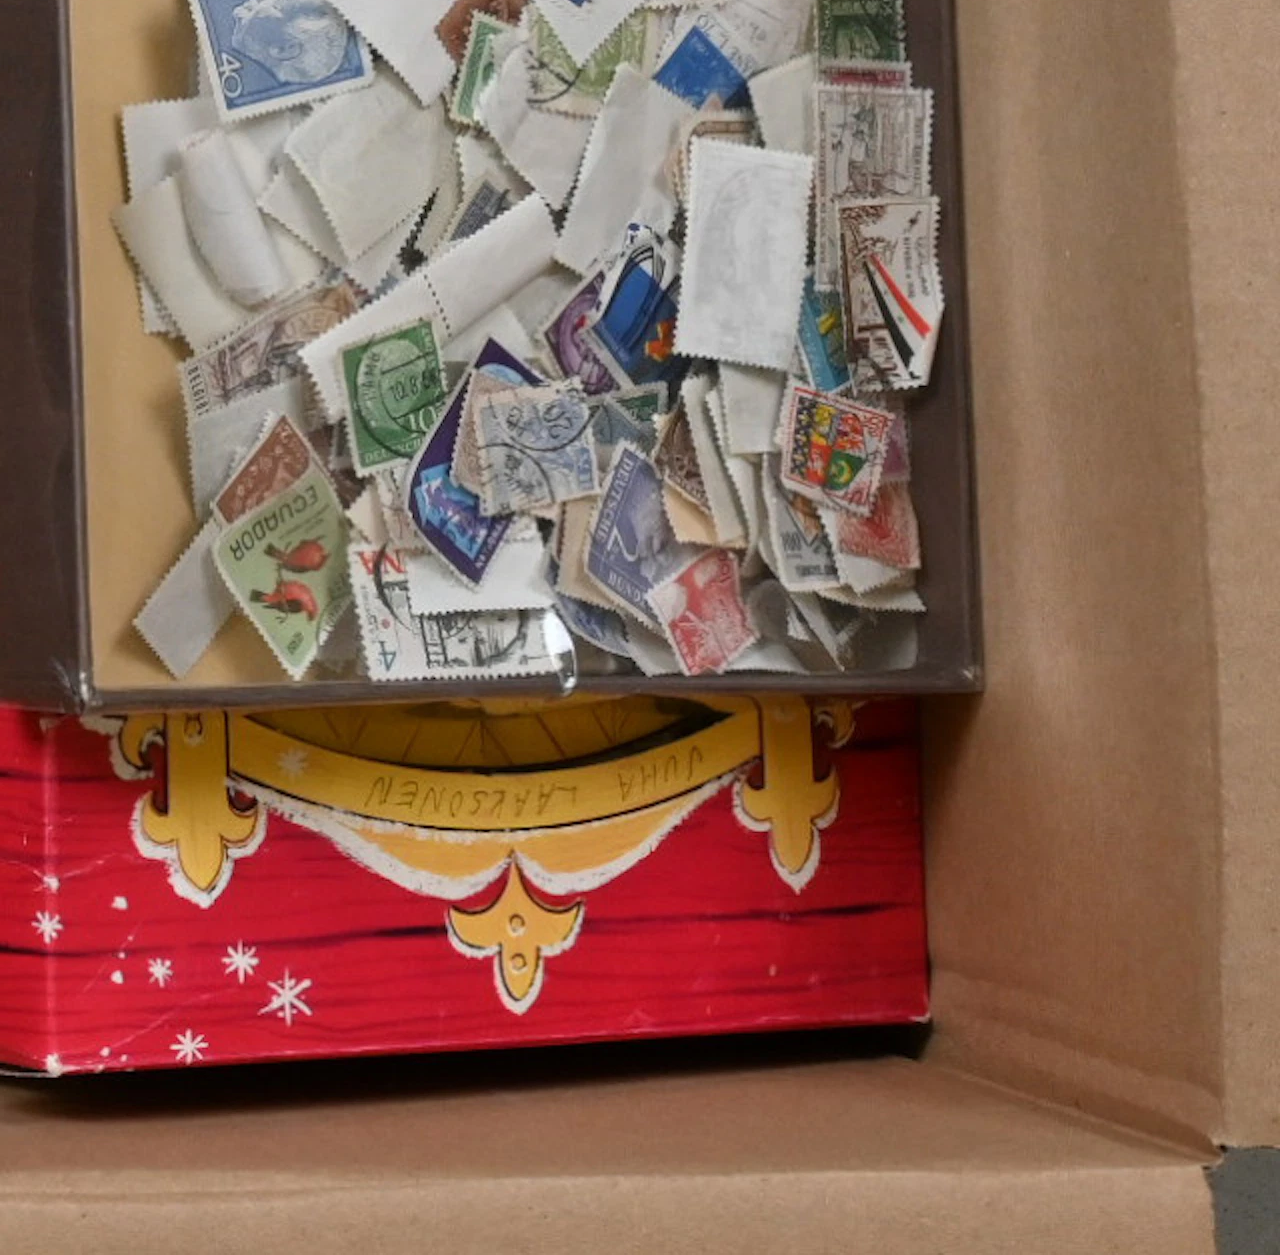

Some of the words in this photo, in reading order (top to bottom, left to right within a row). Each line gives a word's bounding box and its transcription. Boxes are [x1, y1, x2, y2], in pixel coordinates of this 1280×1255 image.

[218, 52, 244, 98] 40
[229, 485, 319, 562] ECUADOR
[596, 454, 635, 543] DEUTSCHE
